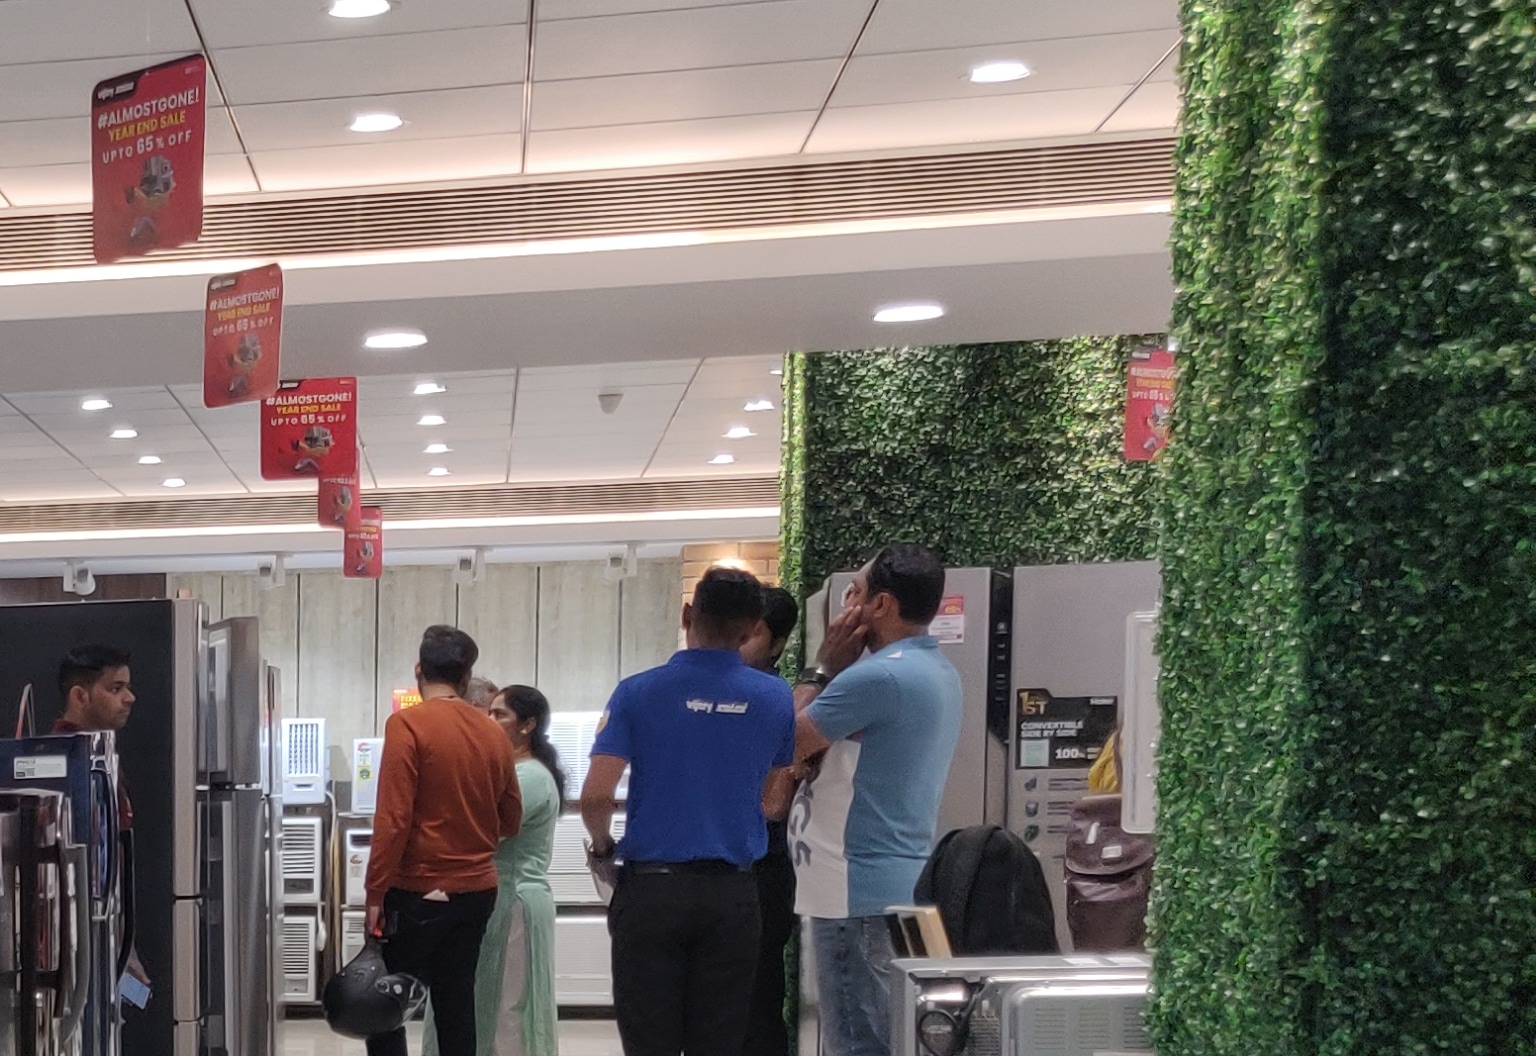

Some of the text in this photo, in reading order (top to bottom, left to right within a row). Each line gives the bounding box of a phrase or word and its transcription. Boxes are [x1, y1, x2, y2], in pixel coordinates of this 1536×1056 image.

[97, 85, 200, 130] #ALMOSTGONE!
[108, 109, 186, 142] YEAR END SALE
[167, 129, 192, 147] OFF
[265, 391, 353, 406] #ALMOSTGONE!
[276, 403, 342, 415] YEAR END SALE
[1020, 720, 1084, 731] CONVERTIBLE
